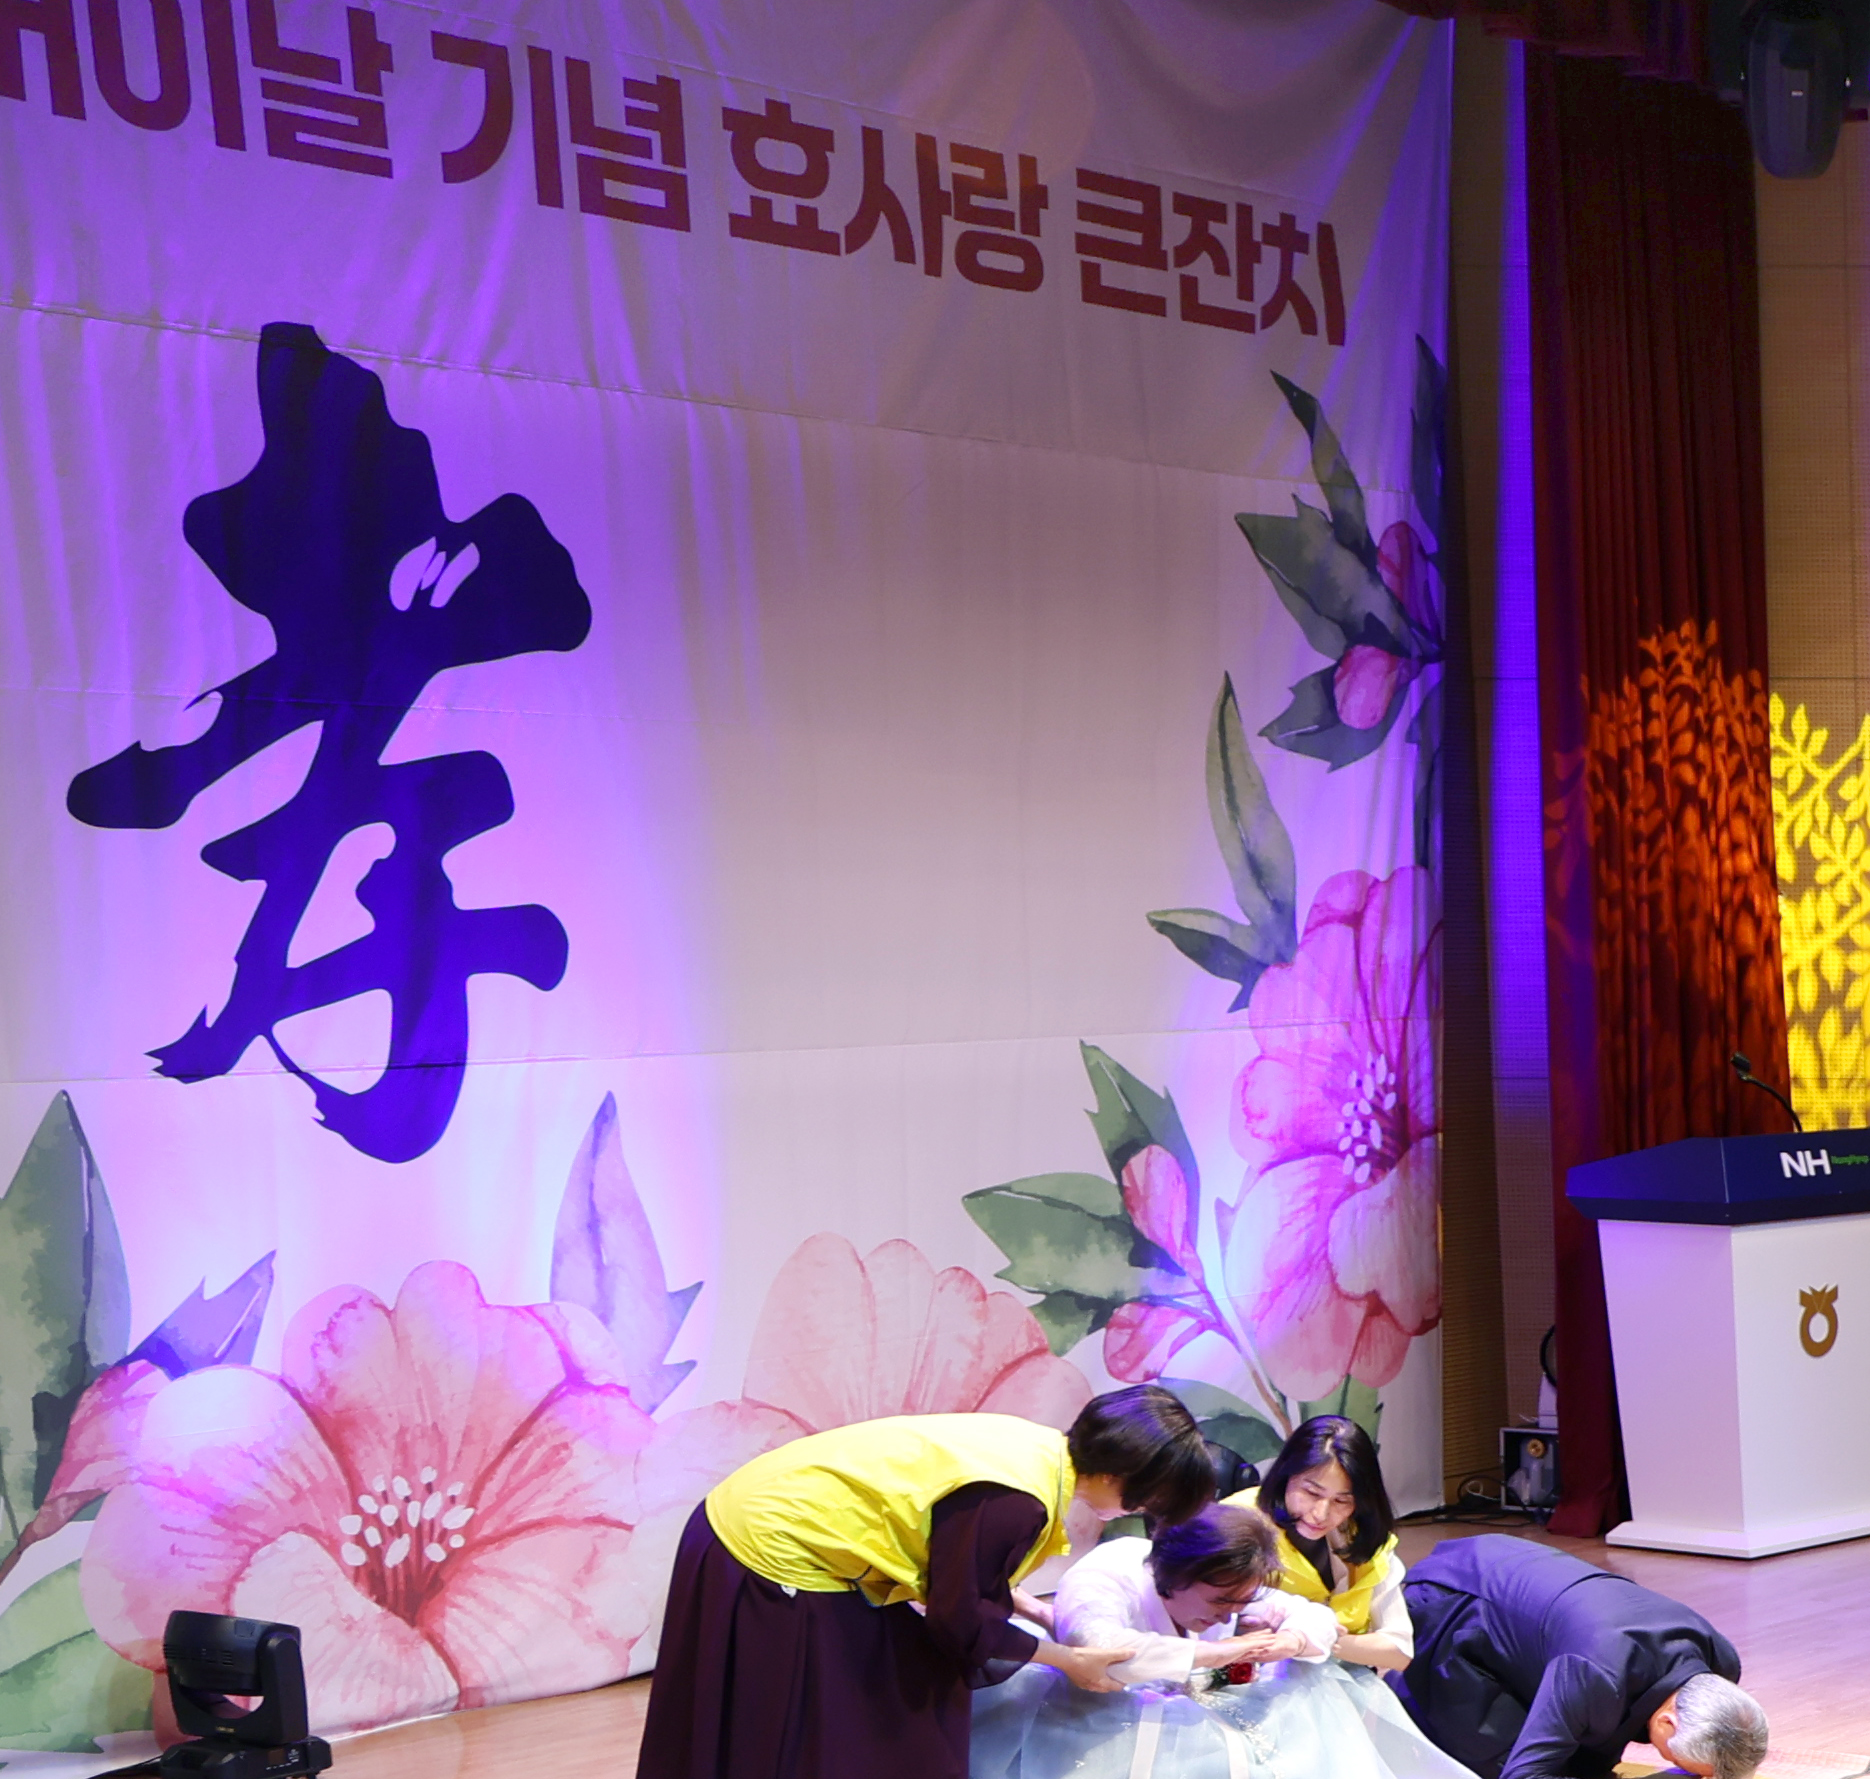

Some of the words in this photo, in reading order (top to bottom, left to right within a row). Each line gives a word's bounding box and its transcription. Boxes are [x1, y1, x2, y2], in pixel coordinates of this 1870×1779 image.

[429, 30, 692, 232] 기념
[721, 100, 1049, 293] 효사랑
[1074, 168, 1346, 346] 큰잔치
[1780, 1149, 1831, 1178] NH
